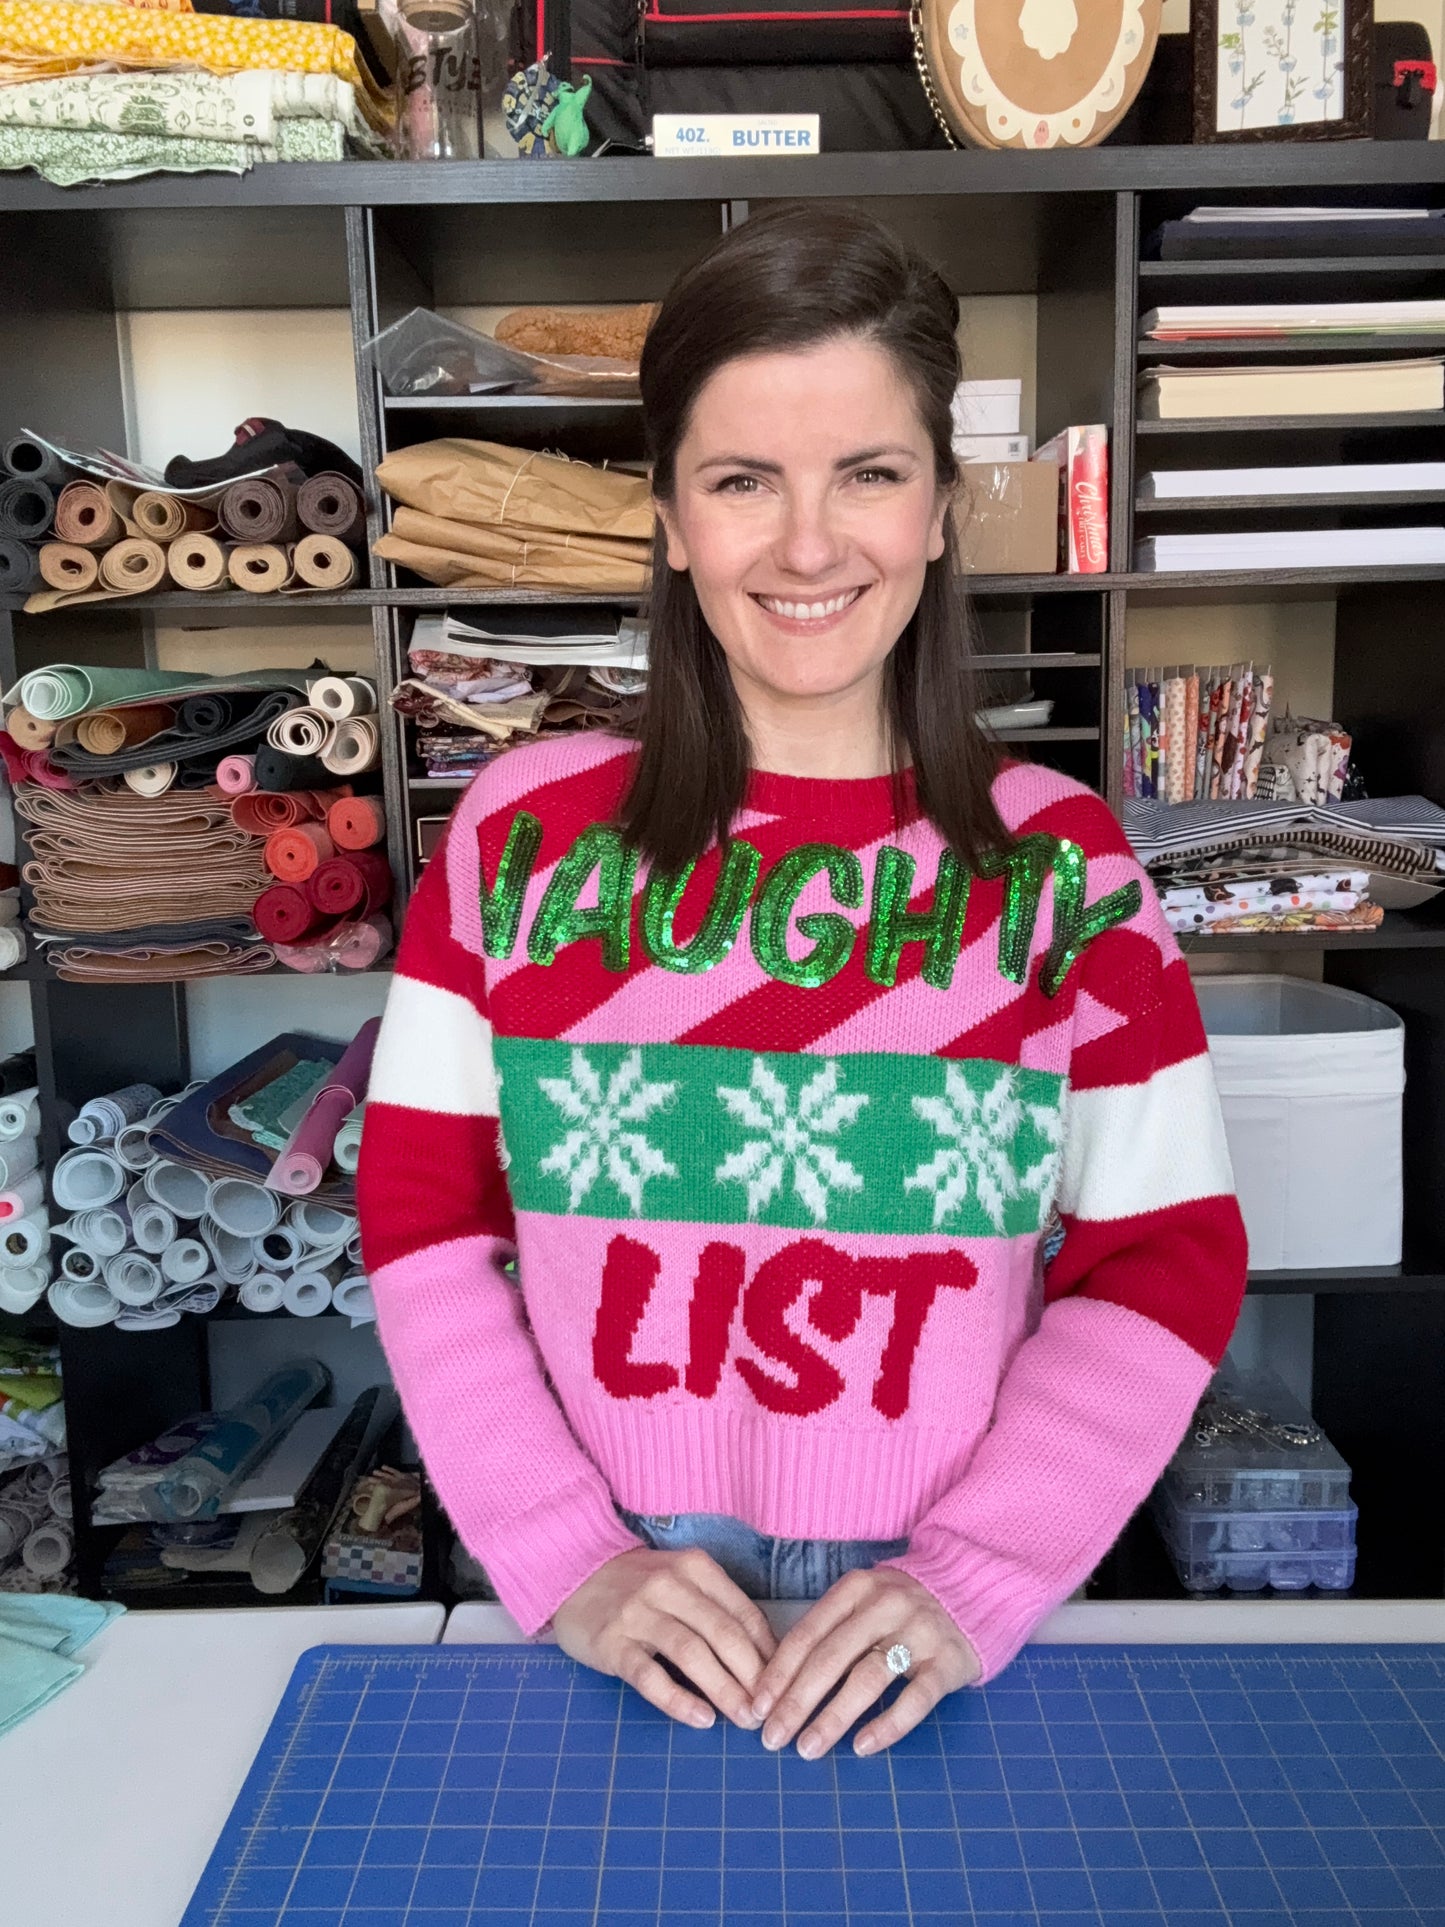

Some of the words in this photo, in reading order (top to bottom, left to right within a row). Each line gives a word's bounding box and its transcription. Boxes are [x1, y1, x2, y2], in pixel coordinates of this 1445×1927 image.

[732, 129, 811, 146] BUTTER
[1075, 481, 1105, 564] Christmas
[592, 1233, 979, 1420] LIST
